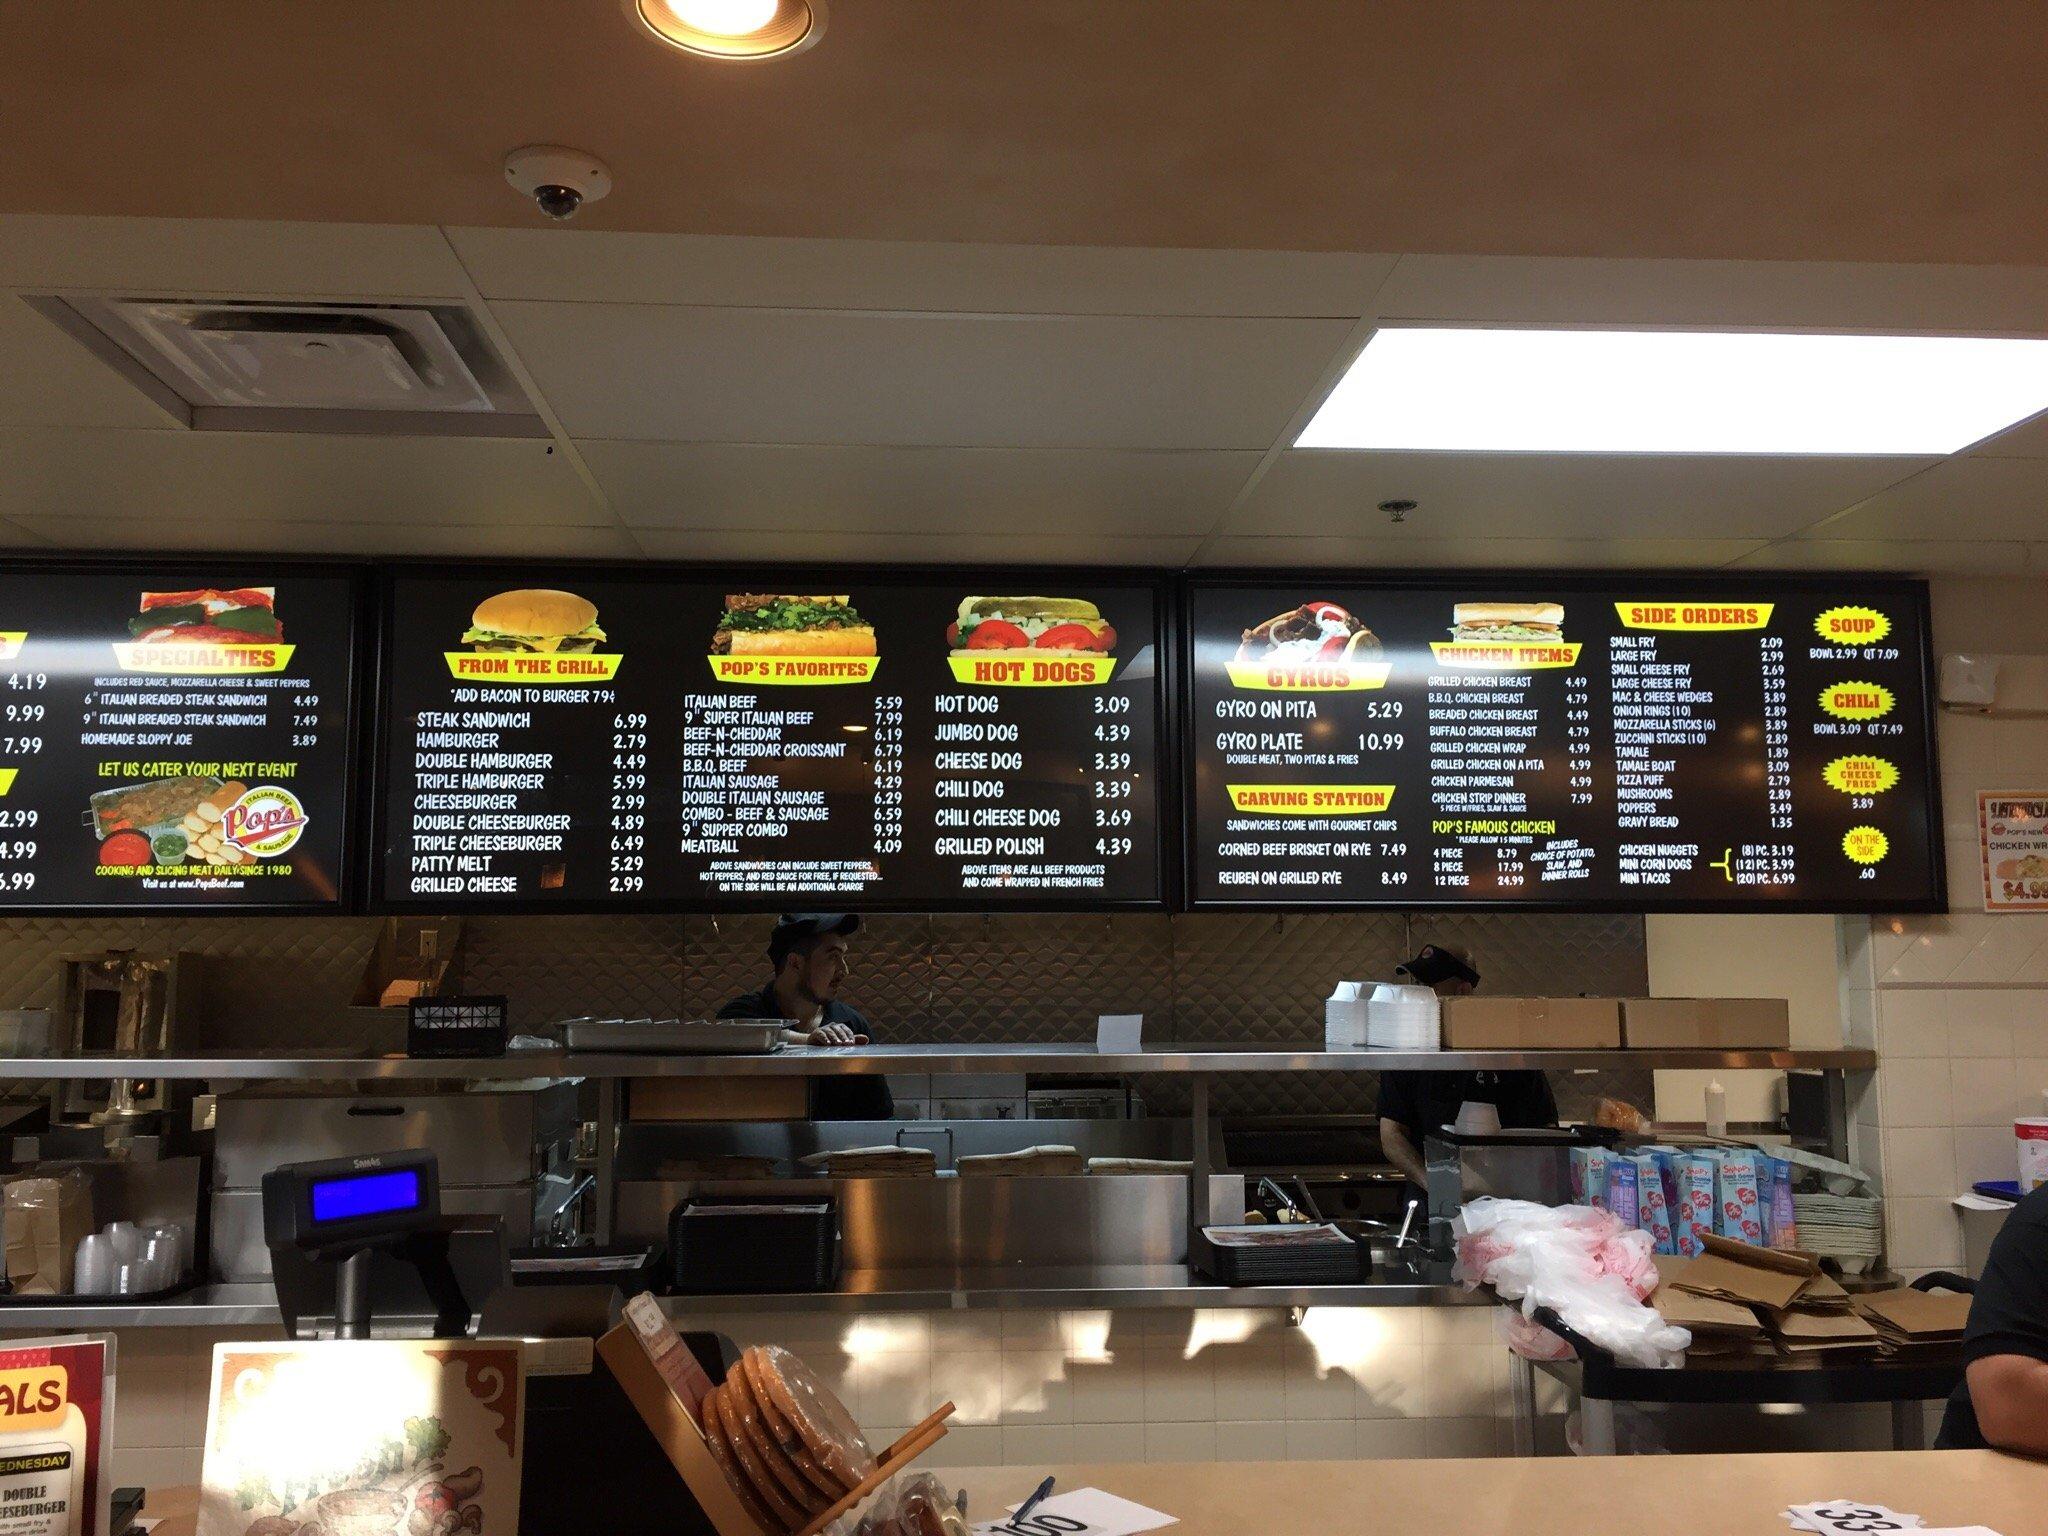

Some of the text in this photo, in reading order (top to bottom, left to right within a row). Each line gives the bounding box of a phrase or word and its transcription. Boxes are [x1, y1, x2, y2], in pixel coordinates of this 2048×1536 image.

[1632, 608, 1758, 624] SIDE ORDERS
[1830, 619, 1875, 633] SOUP
[1610, 636, 1782, 648] SMALL FRY 2.09
[131, 650, 276, 667] SPECIALTIES
[1439, 648, 1573, 663] CHICKEN ITEMS
[1810, 648, 1898, 660] BOWL 2.99 QT 7.09
[459, 659, 608, 674] FROM THE GRILL
[721, 662, 868, 676] POP'S FAVORITES
[975, 662, 1095, 682] HOT DOGS
[8, 673, 47, 690] 4.19
[1267, 667, 1350, 687] GYROS
[685, 695, 902, 709] ITALIAN BEEF 5.59
[936, 695, 1129, 713] HOT DOG 3.09
[1216, 699, 1402, 719] GYRO ON PITA 5.29
[1834, 694, 1879, 708] CHILI
[6, 705, 44, 722] 9.99
[99, 713, 317, 726] ITALIAN BREADED STEAK SANDWICH 7.49
[417, 712, 646, 729] STEAK SANDWICH 6.99
[704, 711, 902, 725] SUPER ITALIAN BEEF 7.99
[1429, 709, 1588, 721] BREADED CHICKEN BREAST 4.49
[81, 733, 316, 746] HOMEMADE SLOPPY JOE 3.89
[684, 727, 902, 741] BEEF-N-CHEDDAR 6.19
[935, 723, 1130, 741] JUMBO DOG 4.39
[4, 737, 42, 754] 7.99
[417, 732, 646, 749] HAMBURGER 2.79
[1217, 732, 1404, 751] GYRO PLATE 10.99
[684, 743, 902, 758] BEEF-N-CHEDDAR CROISSANT 6.79
[1615, 747, 1788, 758] TAMALE 1.89
[416, 753, 645, 769] DOUBLE HAMBURGER 4.49
[935, 752, 1130, 770] CHEESE DOG 3.39
[99, 761, 297, 778] LET US CATER YOUR NEXT EVENT
[415, 773, 645, 789] TRIPLE HAMBURGER 5.99
[683, 791, 902, 805] DOUBLE ITALIAN SAUSAGE 6.29
[1237, 792, 1384, 806] CARVING STATION
[1617, 788, 1791, 799] MUSHROOMS 2.89
[414, 794, 644, 810] CHEESEBURGER 2.99
[1618, 802, 1791, 814] POPPERS 3.49
[414, 814, 644, 830] DOUBLE CHEESEBURGER 4.89
[935, 808, 1131, 826] CHILI CHEESE DOG 3.69
[1433, 820, 1555, 834] POP'S FAMOUS CHICKEN
[681, 839, 902, 853] MEATBALL 4.09
[935, 837, 1131, 855] GRILLED POLISH 4.39
[1218, 842, 1406, 857] CORNED BEEF BRISKET ON RYE 7.49
[1990, 841, 2030, 850] CHICKEN
[412, 855, 643, 872] PATTY MELT 5.29
[962, 864, 1105, 876] ABOVE ITEMS ARE ALL BEEF PRODUCTS
[411, 876, 643, 893] GRILLED CHEESE 2.99
[3, 1486, 47, 1502] DOUBLE
[0, 1501, 66, 1518] ESEBURGER
